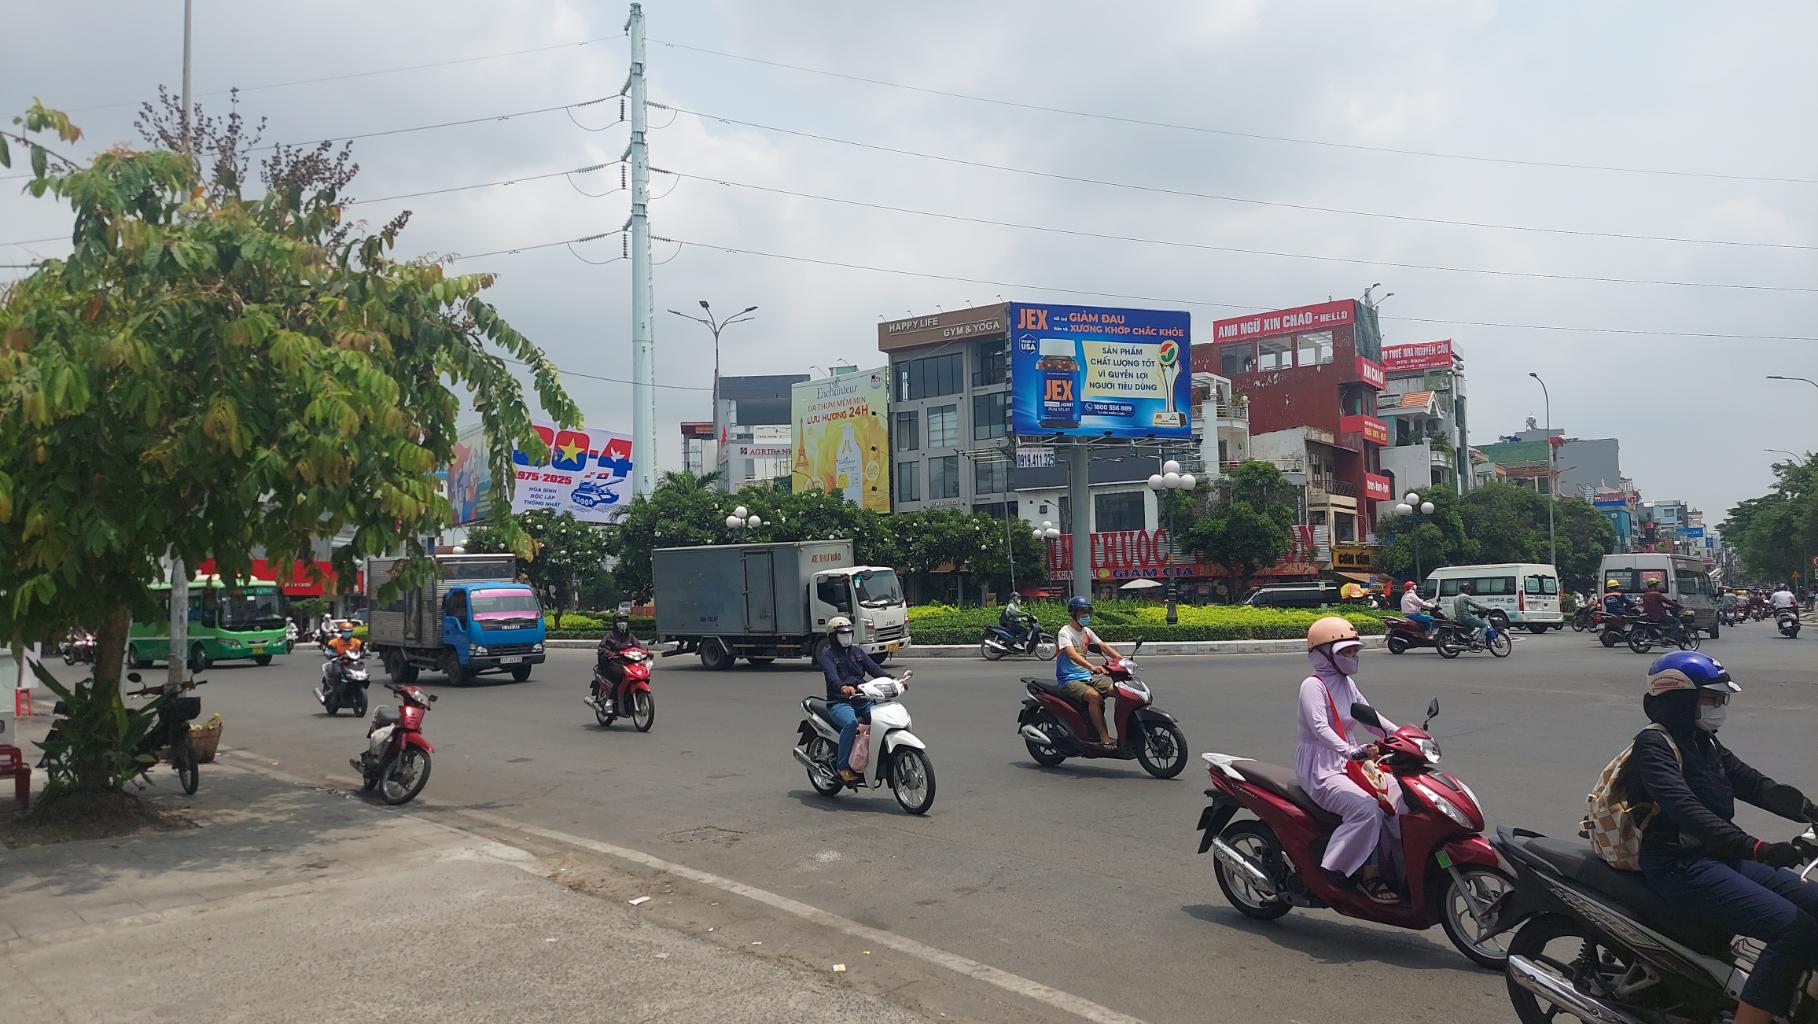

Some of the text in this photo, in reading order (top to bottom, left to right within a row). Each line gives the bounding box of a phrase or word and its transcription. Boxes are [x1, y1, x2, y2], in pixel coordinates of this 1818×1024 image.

[1018, 308, 1048, 330] JEX
[1069, 310, 1098, 322] GIẢM
[1101, 314, 1125, 324] ĐAU
[1218, 324, 1238, 338] ANH
[1240, 318, 1262, 335] NGỮ
[1264, 317, 1281, 331] XIN
[1282, 312, 1312, 328] CHÀO
[1320, 310, 1348, 322] HELLO
[889, 317, 938, 332] HAPPY LIFE
[944, 326, 964, 336] GYM
[973, 321, 1000, 333] YOGA
[1070, 323, 1102, 333] XƯƠNG
[1104, 325, 1130, 334] KHỚP
[1132, 325, 1156, 336] CHẮC
[1160, 326, 1184, 337] KHỎE
[1102, 345, 1143, 355] SẢN PHẨM
[1090, 356, 1155, 367] CHẤT LƯỢNG TỐT
[1098, 369, 1148, 381] VÌ QUYỀN LỢI
[1044, 380, 1073, 400] JEX
[1089, 381, 1157, 391] NGƯỜI TIÊU DÙNG
[849, 404, 868, 417] 24H
